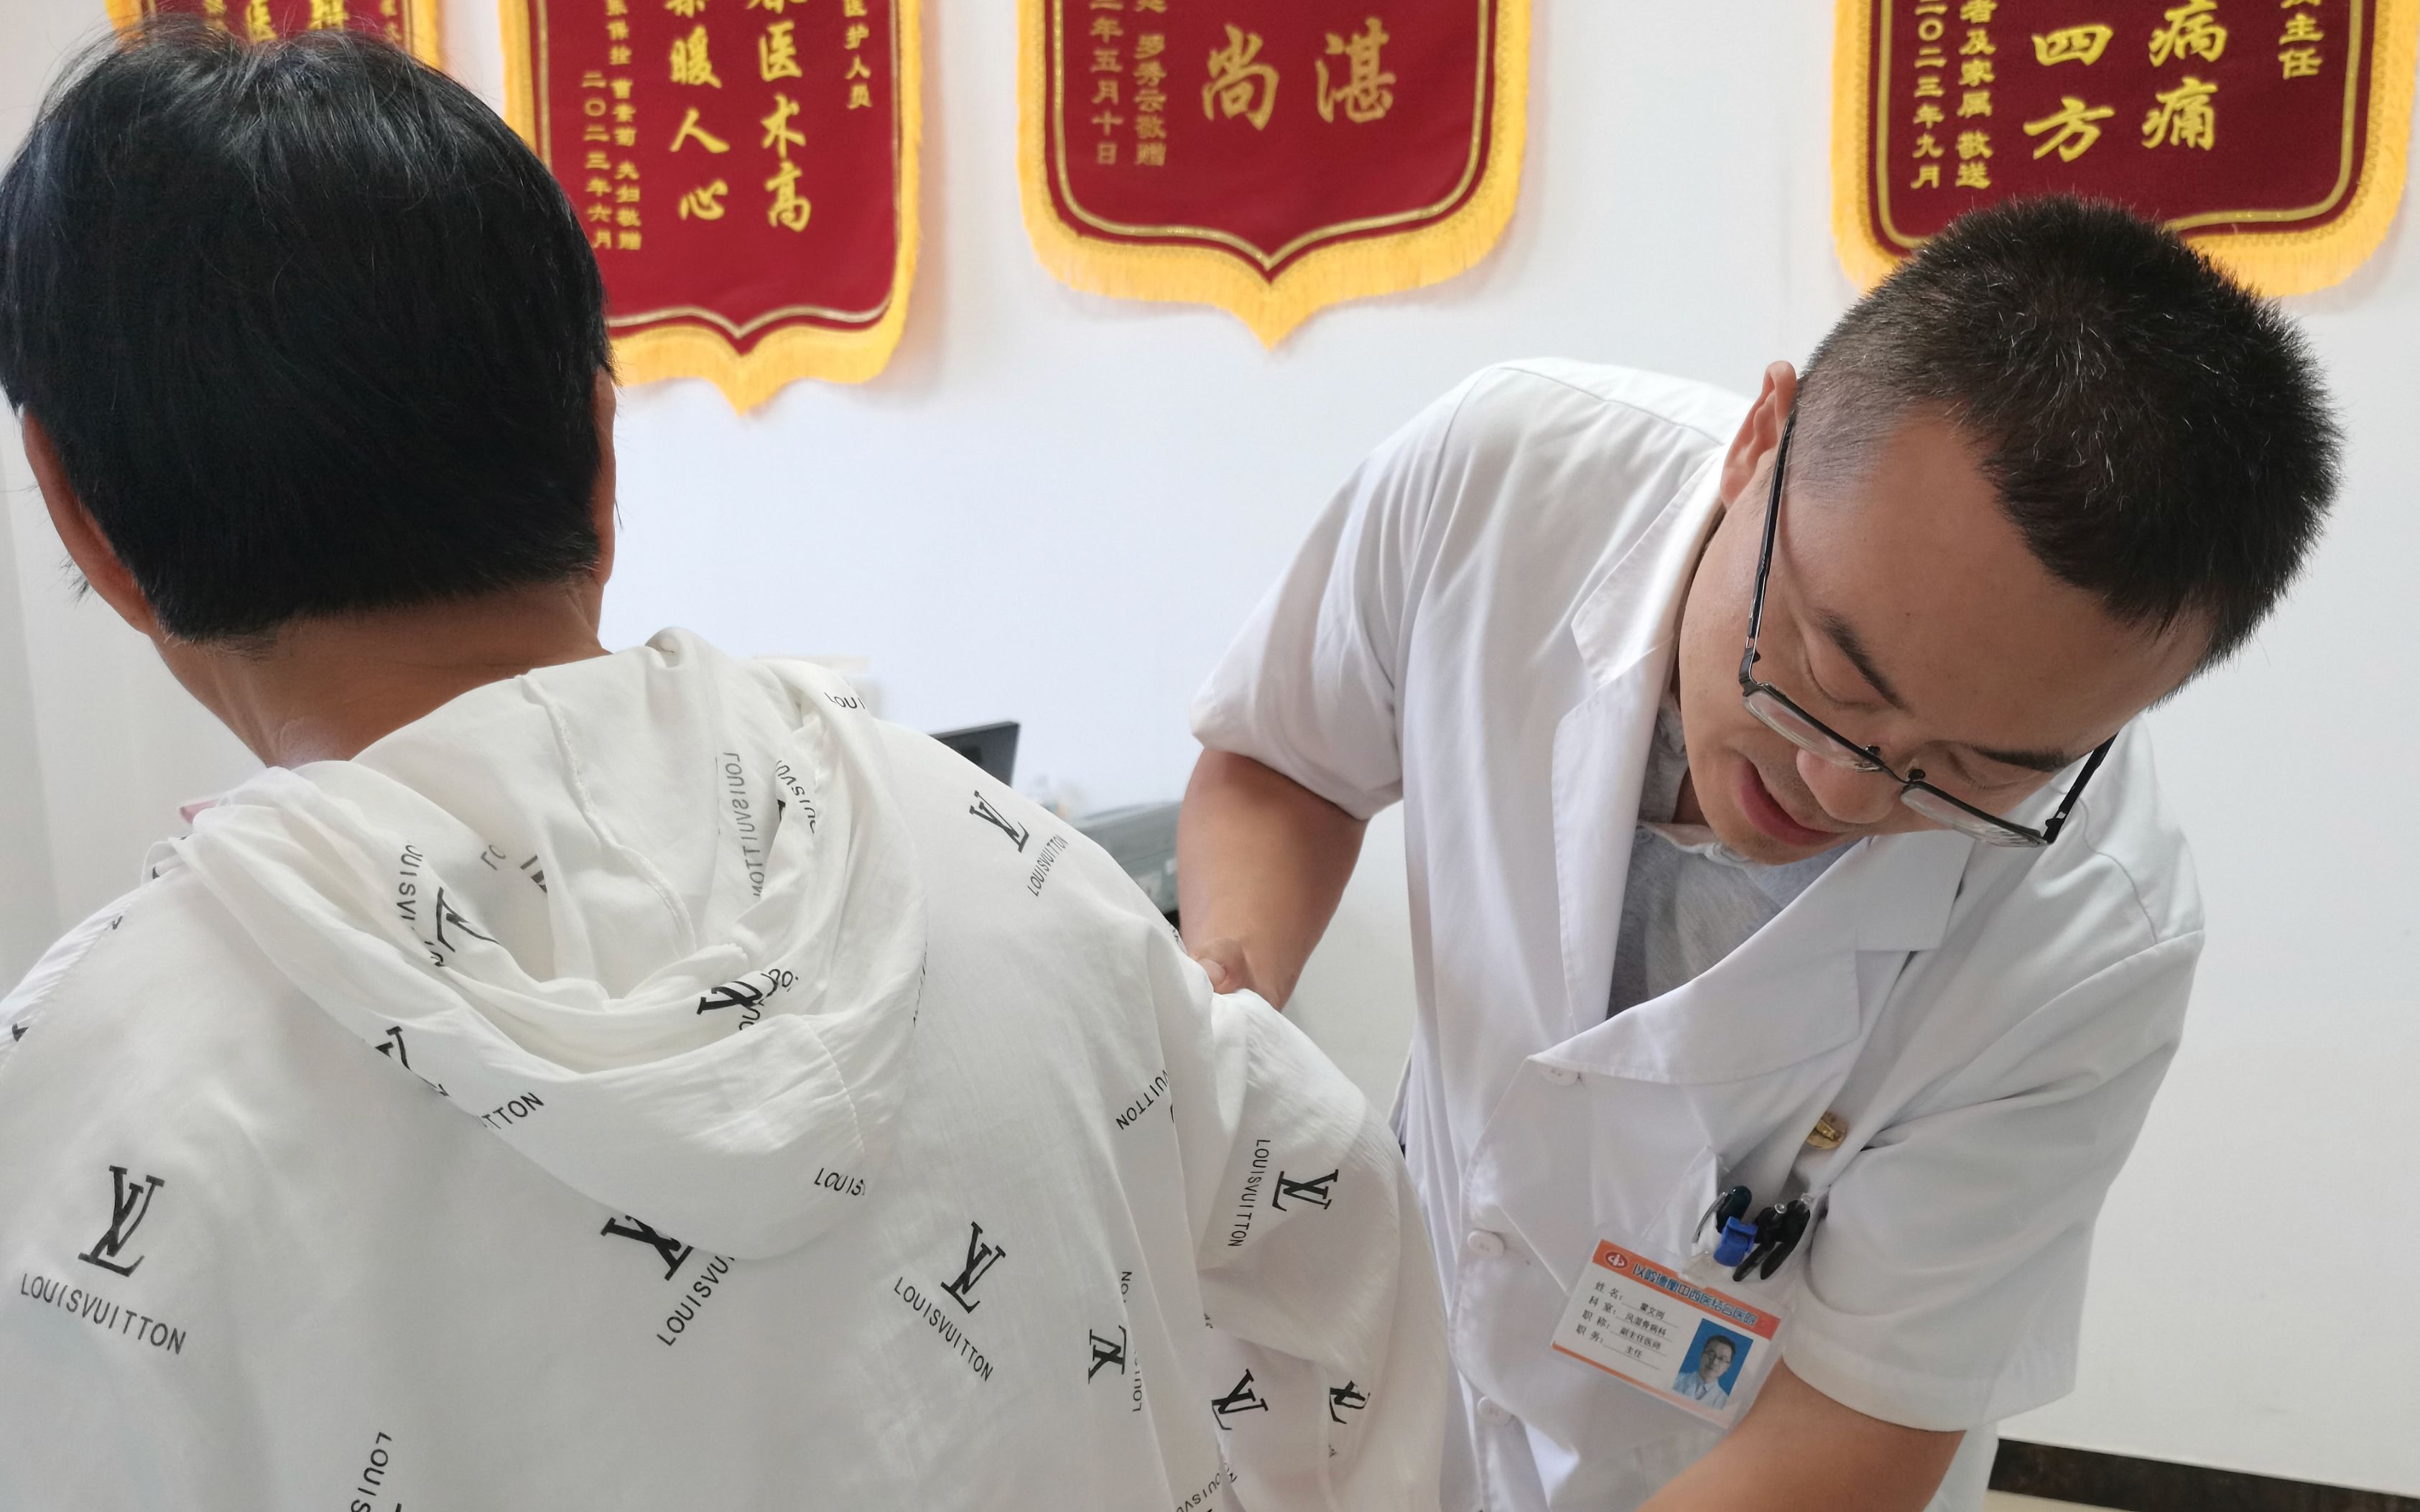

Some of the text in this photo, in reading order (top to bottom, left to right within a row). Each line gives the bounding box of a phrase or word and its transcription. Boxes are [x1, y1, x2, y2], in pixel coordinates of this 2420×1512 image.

[1202, 24, 1280, 131] 尚
[1315, 17, 1396, 124] 湛
[2023, 22, 2115, 163] 四方
[2141, 0, 2227, 150] 病痛
[2278, 0, 2325, 80] 主任
[665, 0, 731, 221] 暖人心
[745, 0, 811, 232] 医术高
[1027, 833, 1070, 898] LOUISVUITTON
[1227, 1138, 1271, 1247] LOUISVUITTON
[20, 1273, 187, 1355] LOUISVUITTON
[656, 1255, 736, 1347] LOUISVU
[893, 1276, 993, 1383] LOUISVUITTON
[1626, 1345, 1644, 1359] 主任
